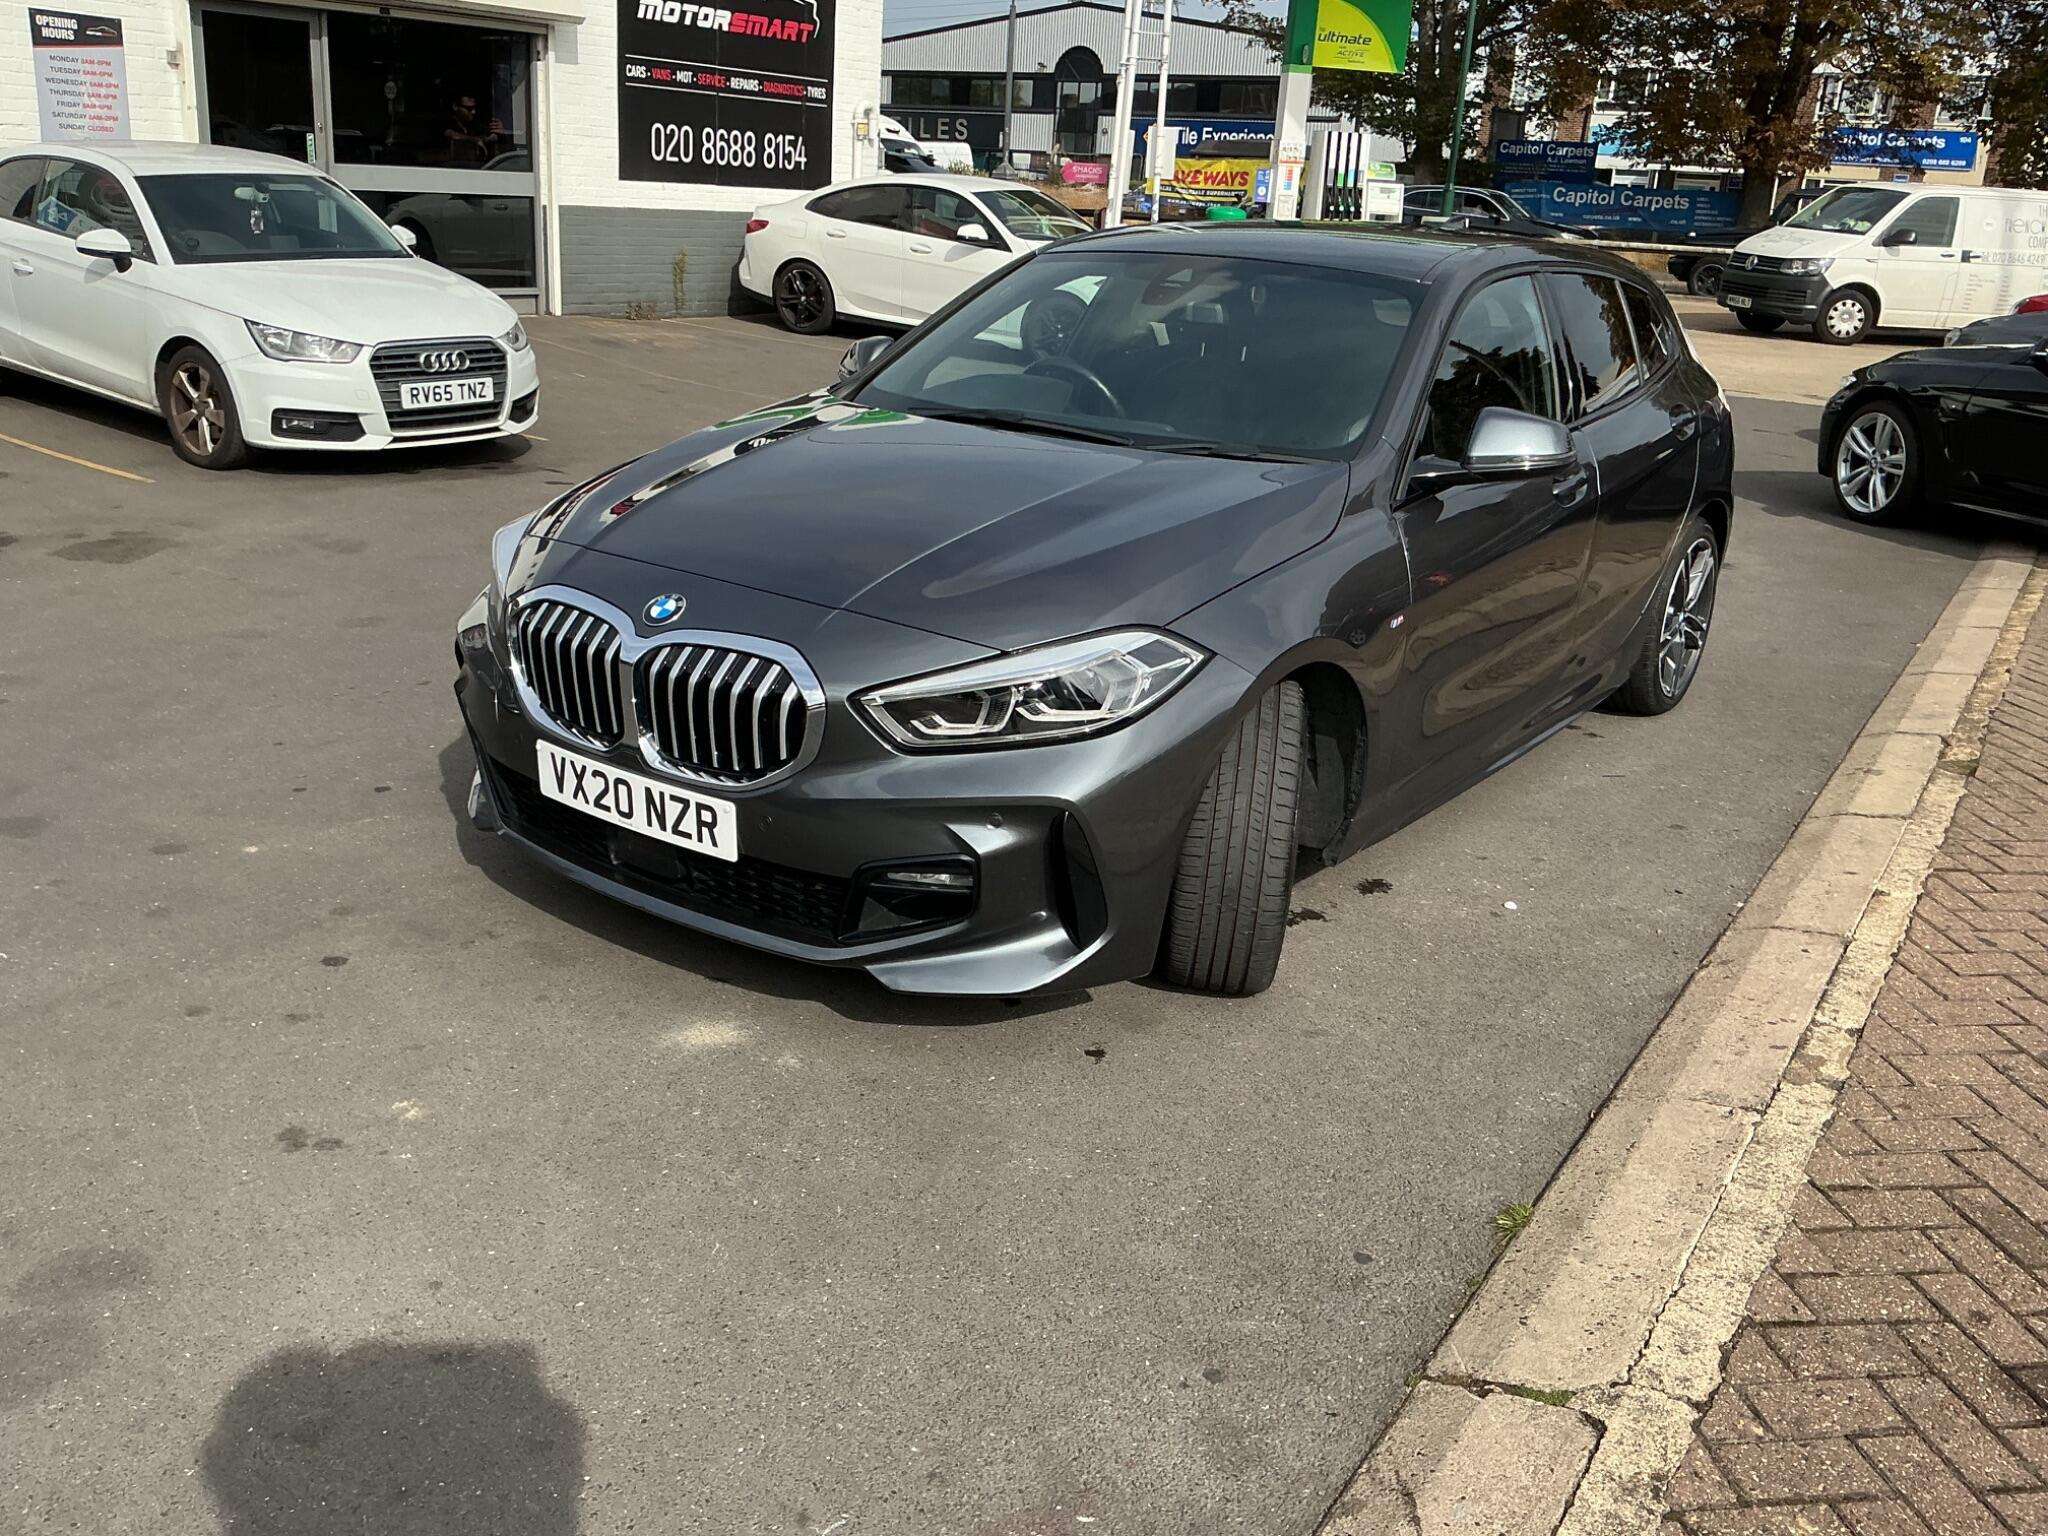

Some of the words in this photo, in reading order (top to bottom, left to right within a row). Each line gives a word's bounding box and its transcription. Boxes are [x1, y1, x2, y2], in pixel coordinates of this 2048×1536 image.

[35, 15, 78, 29] OPENING
[636, 0, 815, 44] MOTORSMART
[42, 27, 75, 40] HOURS
[1318, 31, 1372, 45] ultimate
[49, 54, 79, 64] MONDAY
[50, 65, 81, 74] TUESDAY
[45, 76, 88, 87] WEDNESDAY
[626, 63, 646, 79] CARS
[651, 67, 672, 81] VANS
[676, 70, 693, 84] MOT
[697, 73, 726, 88] SERVICE
[730, 77, 759, 92] REPAIRS
[763, 81, 804, 97] DIAGNOSTICS
[807, 86, 827, 100] TYRES
[50, 88, 86, 98] THURSDAY
[56, 99, 81, 109] FRIDAY
[52, 111, 87, 120] SATURDAY
[58, 122, 86, 131] SUNDAY
[87, 125, 115, 134] CLOSED
[890, 116, 969, 141] ILES
[650, 121, 694, 164] 020
[701, 126, 756, 167] 8688
[763, 132, 808, 171] 8154
[1499, 141, 1544, 157] Capitol
[1546, 143, 1595, 159] Carpets
[1173, 169, 1250, 187] AVEWAYS
[1553, 187, 1615, 207] Capitol
[1620, 190, 1690, 212] Carpets
[410, 385, 454, 404] RV65
[458, 382, 486, 399] TNZ
[550, 752, 635, 821] VX20
[643, 786, 719, 849] NZR
